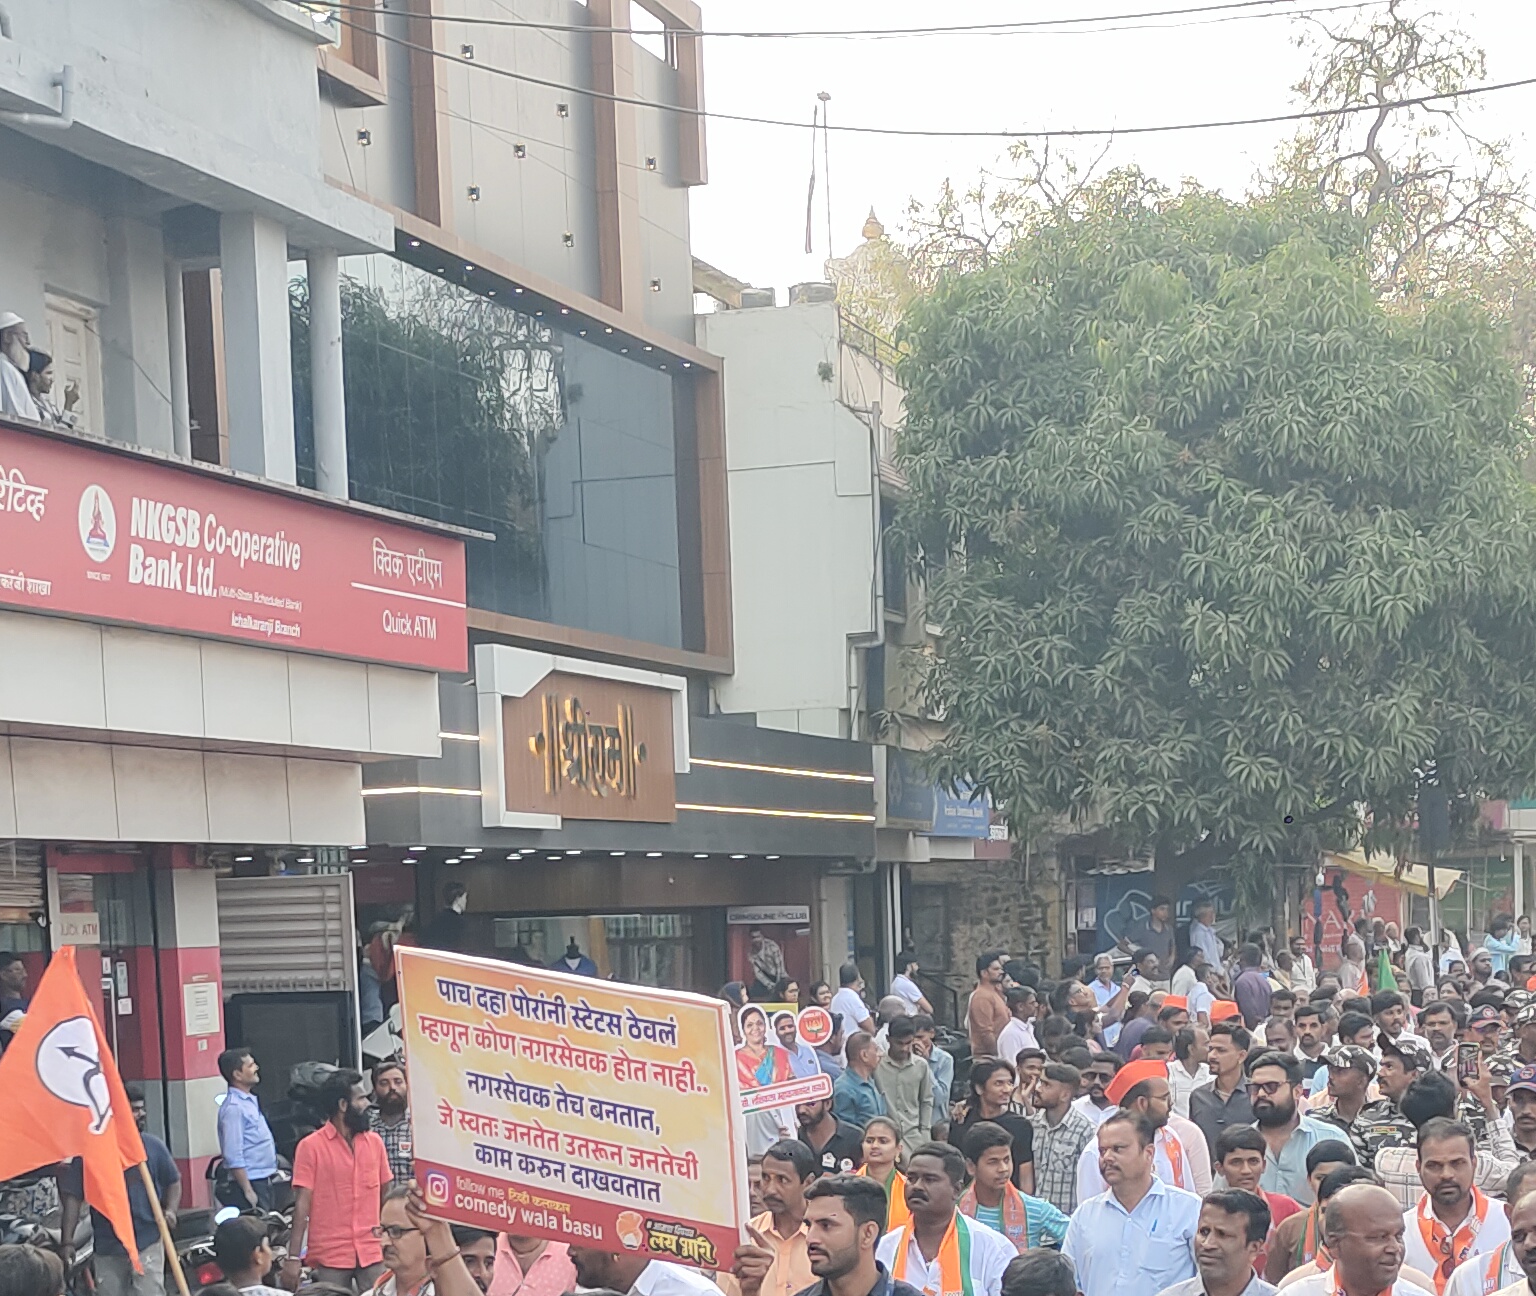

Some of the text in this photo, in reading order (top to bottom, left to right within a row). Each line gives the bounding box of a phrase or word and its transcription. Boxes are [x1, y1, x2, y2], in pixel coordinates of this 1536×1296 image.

[131, 497, 302, 572] NKGSB Co-operative
[128, 544, 184, 594] Bank
[186, 555, 217, 598] Ltd.
[407, 547, 443, 589] एटीएम
[275, 619, 301, 638] Branch
[382, 609, 437, 641] Quick ATM
[82, 923, 98, 935] ATM
[436, 978, 677, 1046] पाच दहा पोरांनी स्टेटस ठेवलं
[418, 1014, 470, 1054] म्हणून
[473, 1021, 517, 1057] कोण
[519, 1036, 607, 1074] नगरसेवक
[611, 1047, 647, 1083] होत
[465, 1071, 661, 1136] नगरसेवक तेच बनतात,
[437, 1098, 454, 1129] जे
[456, 1108, 499, 1137] स्वतः
[501, 1118, 560, 1153] जनतेत
[626, 1144, 699, 1181] जनतेची
[455, 1176, 505, 1200] follow me
[473, 1141, 514, 1172] काम
[570, 1164, 662, 1205] दाखवतात
[454, 1193, 604, 1241] comedy wala basu
